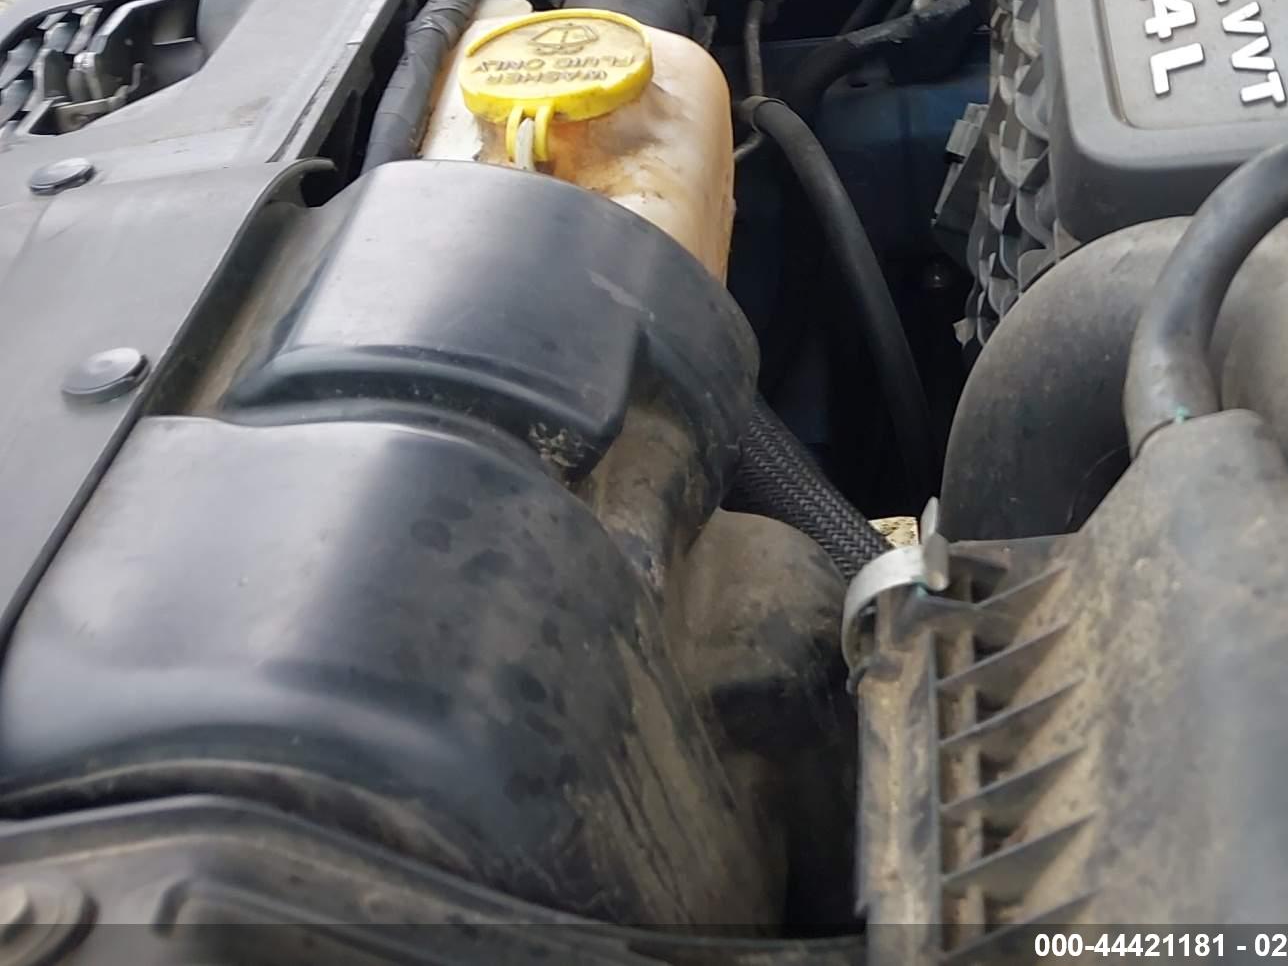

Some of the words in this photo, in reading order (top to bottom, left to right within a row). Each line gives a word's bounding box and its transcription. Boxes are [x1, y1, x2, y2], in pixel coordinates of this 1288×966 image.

[1222, 1, 1287, 105] VVT
[471, 58, 546, 74] ONLY
[553, 55, 635, 70] FLUID
[486, 68, 608, 85] WASHER
